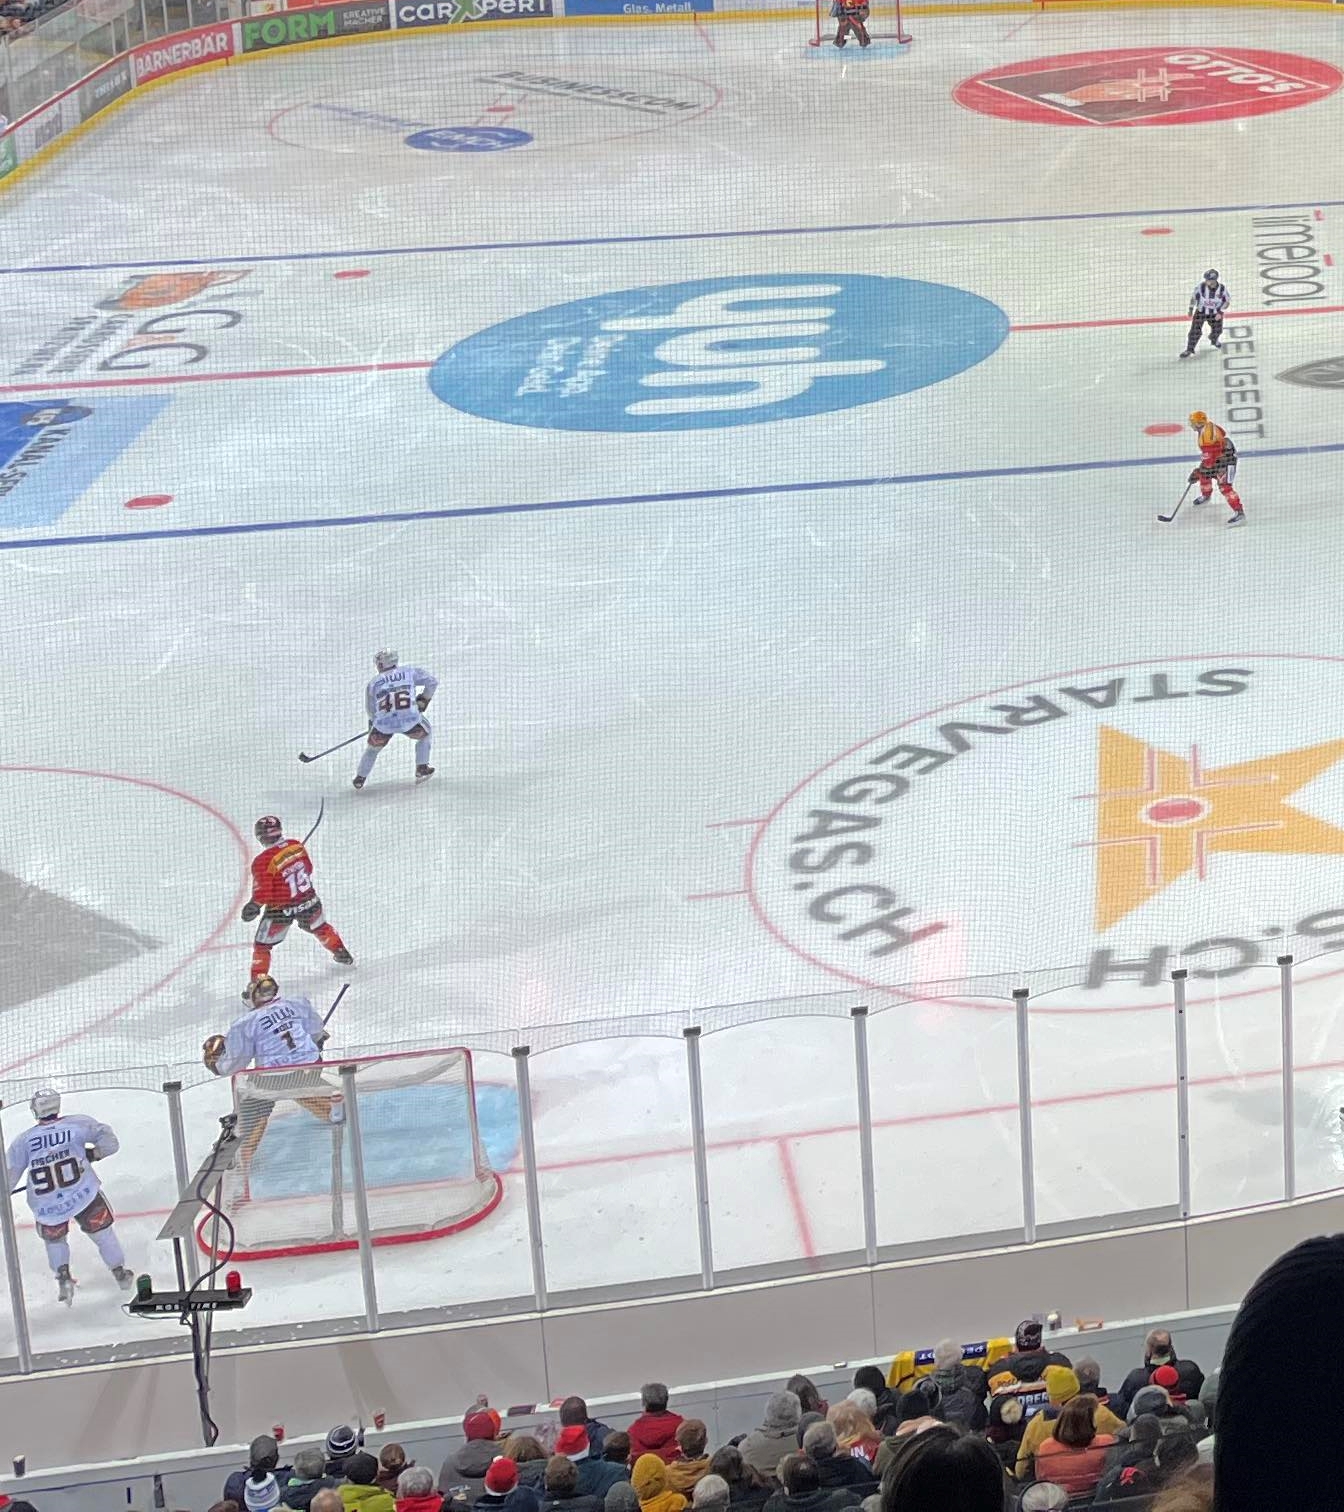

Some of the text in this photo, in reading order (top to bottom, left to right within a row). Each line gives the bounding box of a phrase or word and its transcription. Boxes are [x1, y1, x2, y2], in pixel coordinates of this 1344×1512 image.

[244, 8, 337, 50] FORM
[135, 31, 229, 78] BÄRNERBÄR
[1164, 50, 1307, 95] OTTO'S
[608, 284, 886, 418] yuh
[1219, 324, 1265, 439] PEUGEOT
[377, 690, 411, 713] 46
[280, 1030, 297, 1051] 1
[29, 1159, 81, 1196] 90
[30, 1148, 70, 1168] FISCHER
